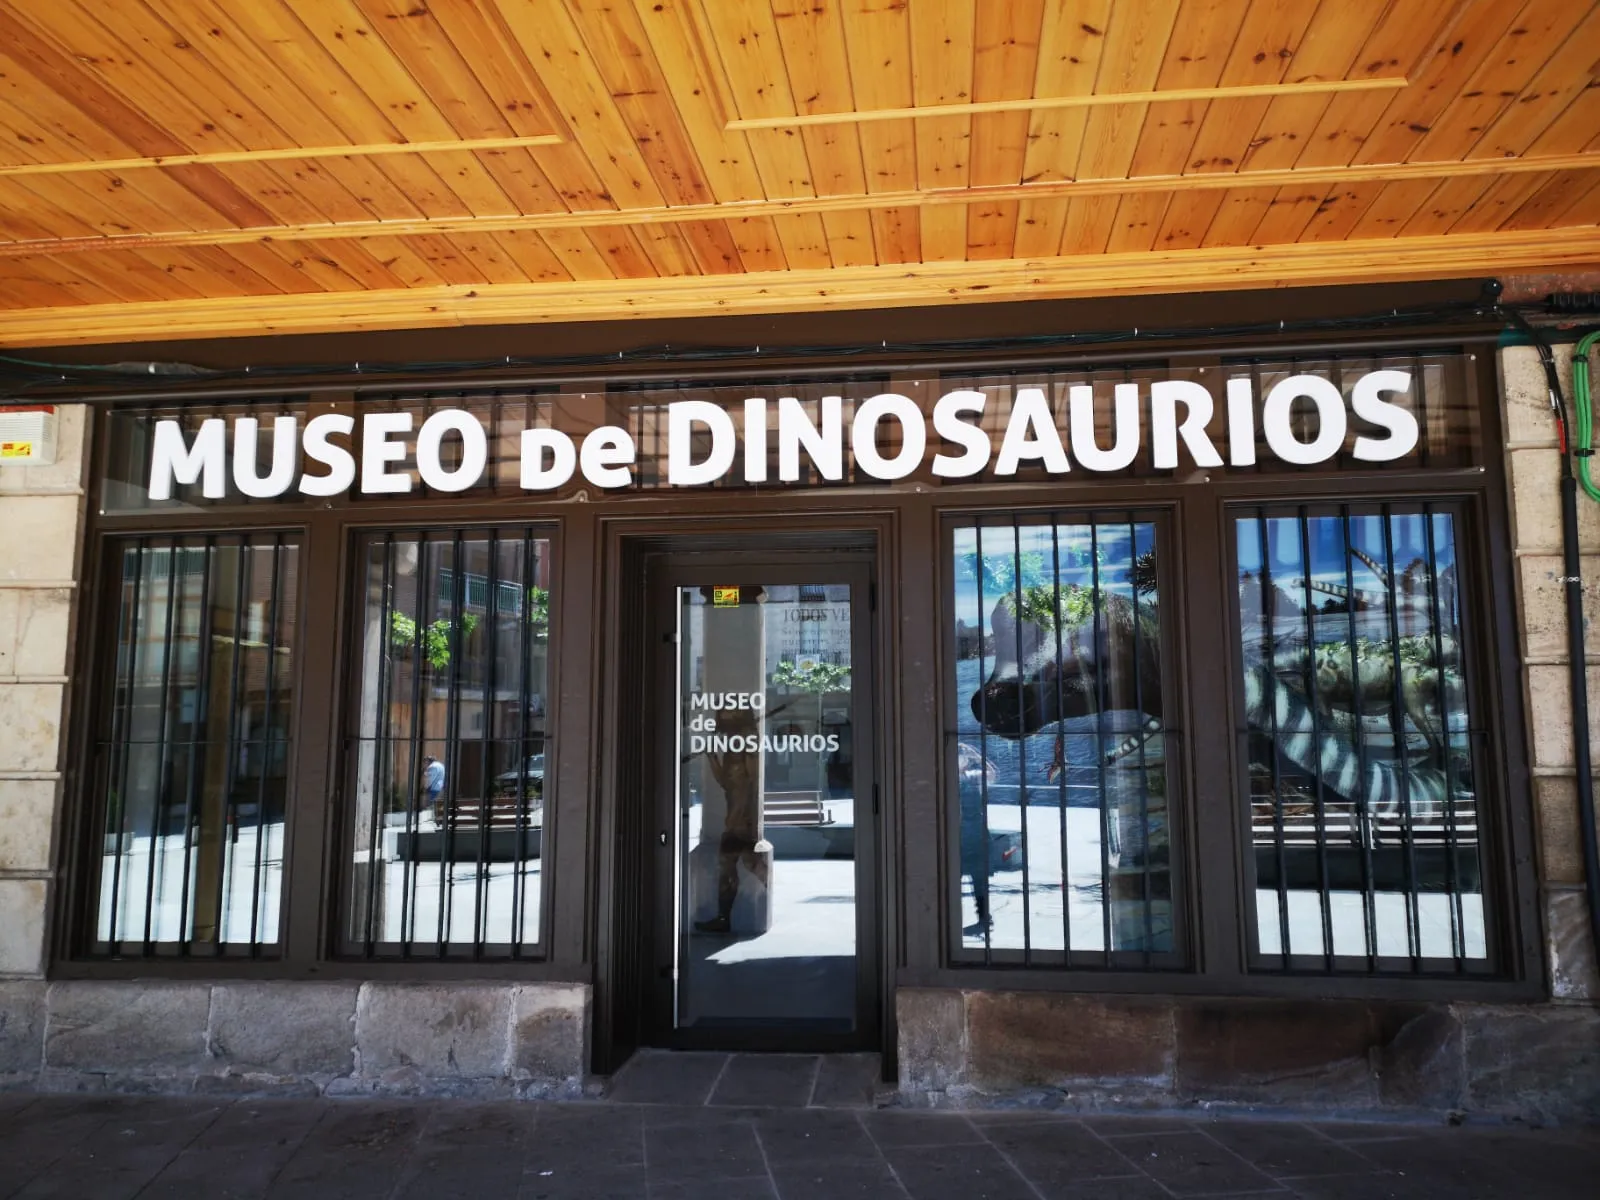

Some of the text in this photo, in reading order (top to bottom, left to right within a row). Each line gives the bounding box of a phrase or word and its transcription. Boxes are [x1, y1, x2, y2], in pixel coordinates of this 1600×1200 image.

[148, 408, 488, 501] MUSEO
[667, 370, 1420, 487] DINOSAURIOS
[690, 692, 766, 711] MUSEO
[690, 714, 717, 732] de
[690, 734, 840, 753] DINOSAURIOS
